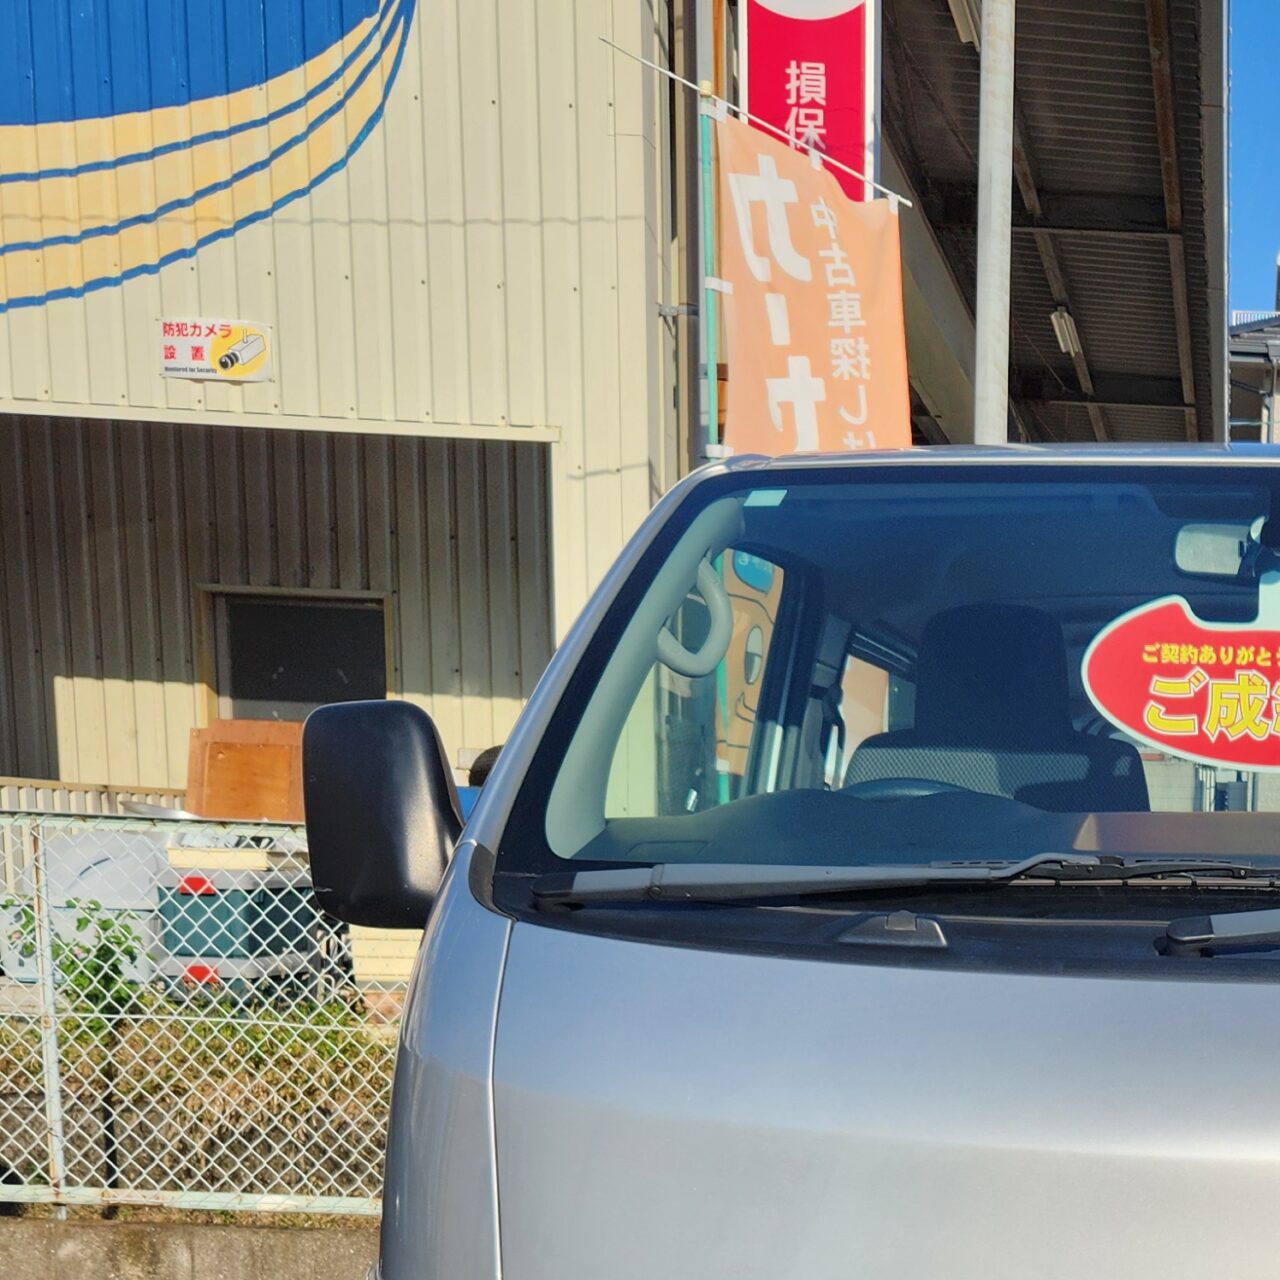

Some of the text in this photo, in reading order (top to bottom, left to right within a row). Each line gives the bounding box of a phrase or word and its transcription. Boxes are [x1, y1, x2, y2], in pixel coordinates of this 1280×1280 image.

[162, 321, 232, 339] 防犯カメラ
